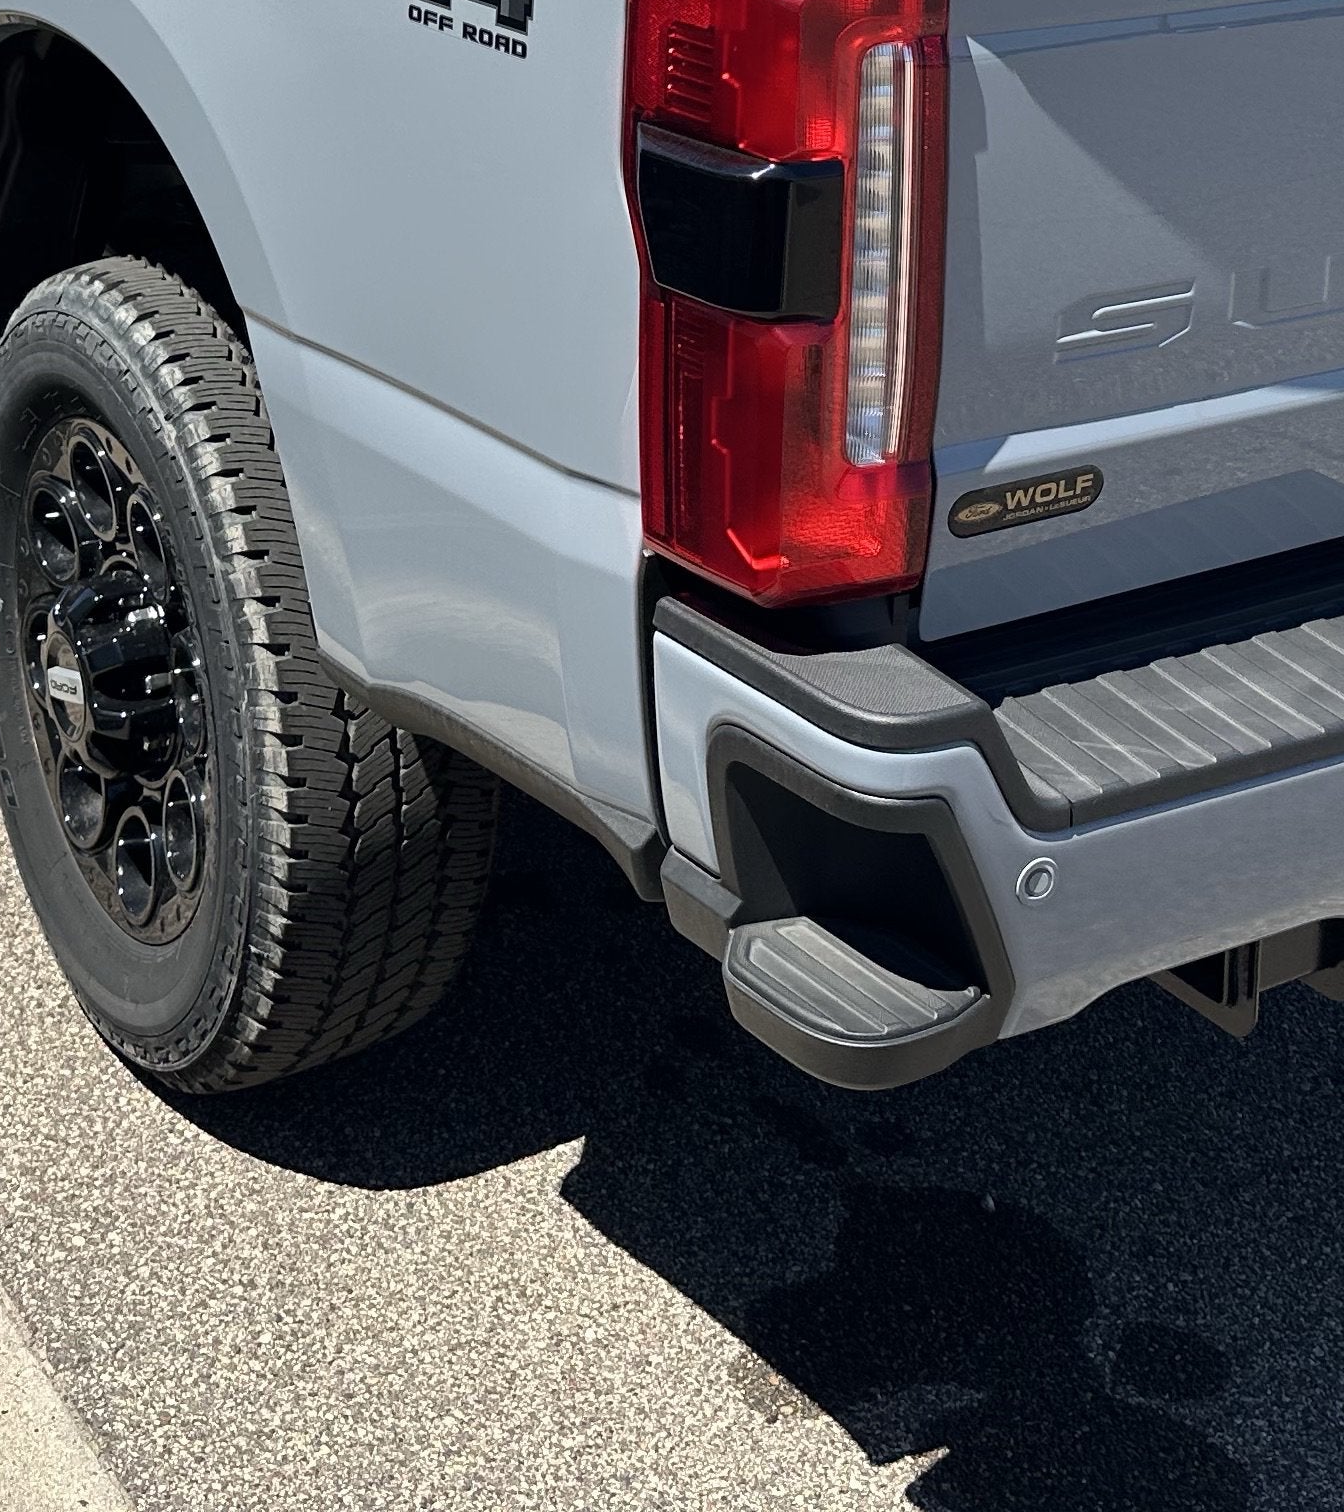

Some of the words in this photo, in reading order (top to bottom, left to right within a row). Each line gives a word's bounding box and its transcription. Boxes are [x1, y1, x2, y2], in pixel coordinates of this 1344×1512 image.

[408, 3, 454, 31] OFF
[462, 21, 528, 59] ROAD
[1005, 473, 1094, 510] WOLF
